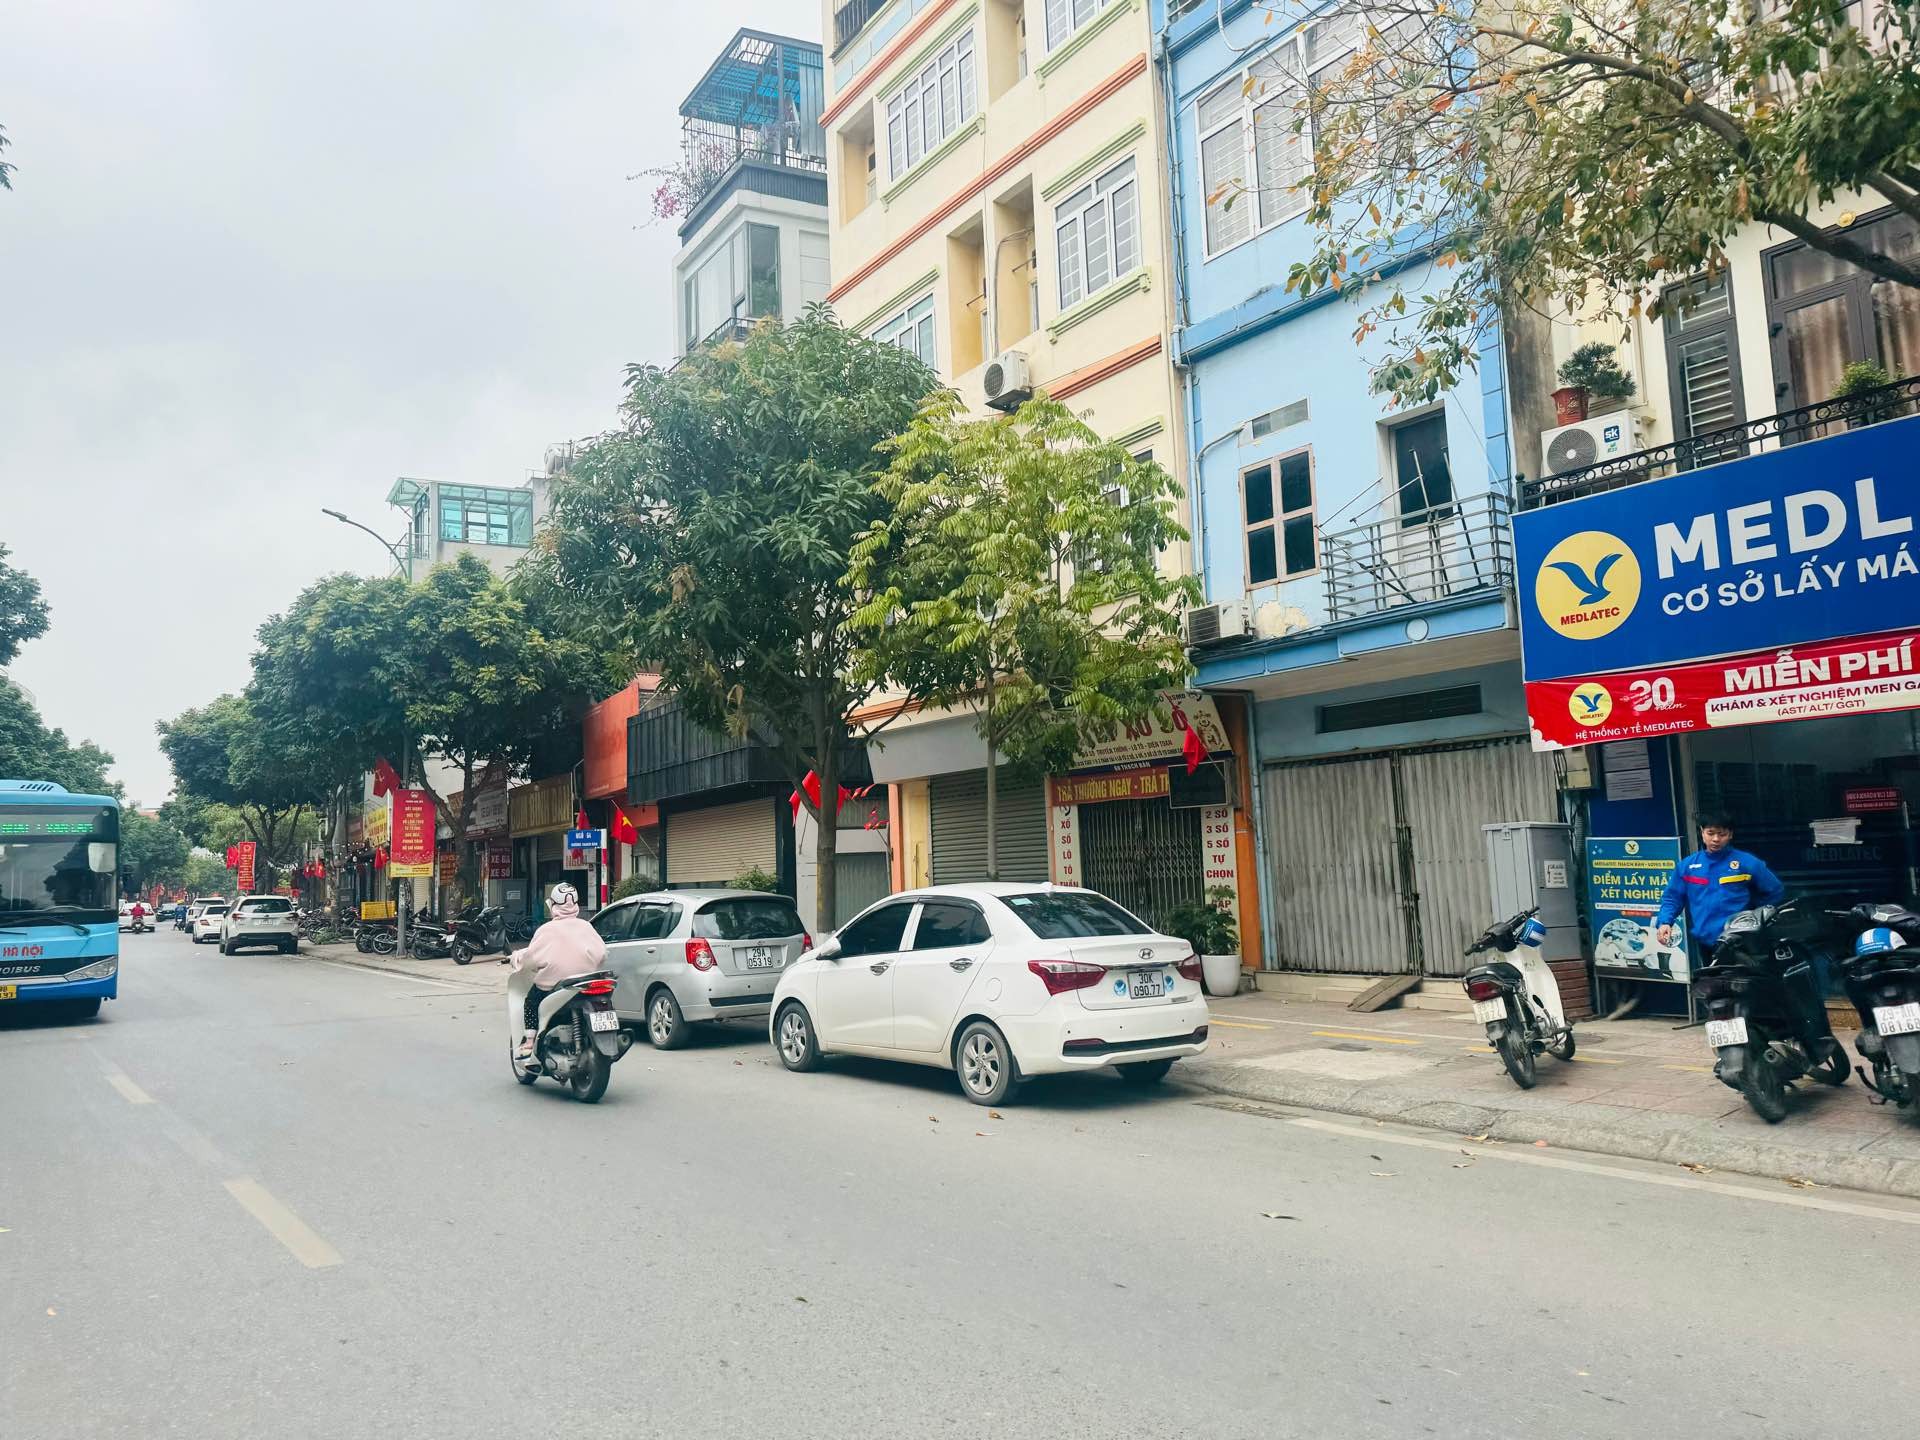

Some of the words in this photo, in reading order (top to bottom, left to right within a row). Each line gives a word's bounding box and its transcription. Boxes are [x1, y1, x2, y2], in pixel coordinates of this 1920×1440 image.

[1653, 477, 1913, 580] MEDL
[1661, 583, 1710, 616] CƠ
[1718, 570, 1765, 605] SỞ
[1775, 555, 1846, 598] LẤY
[1857, 542, 1919, 583] MÁ
[1560, 606, 1620, 626] MEDLATEC
[1724, 649, 1831, 693] MIỄN
[1838, 637, 1915, 679] PHÍ
[1711, 697, 1753, 713] KHÁM
[1756, 698, 1767, 708] &
[1768, 693, 1795, 705] XÉT
[1800, 687, 1861, 702] NGHIỆM
[1864, 682, 1901, 694] MEN
[1777, 706, 1807, 717] (AST/
[1809, 702, 1834, 713] ALT/
[1835, 699, 1866, 710] GGT)
[1575, 729, 1587, 741] HỆ
[1589, 723, 1621, 738] THỐNG
[1622, 727, 1630, 735] Y
[1630, 721, 1642, 734] TẾ
[1643, 719, 1695, 733] MEDLATEC
[1109, 777, 1131, 797] NGAY
[1140, 769, 1158, 794] TRẢ
[1205, 810, 1212, 819] 2
[1214, 807, 1228, 819] SỐ
[1206, 825, 1212, 834] 3
[1215, 822, 1229, 834] SỐ
[1207, 840, 1213, 849] 5
[1216, 837, 1230, 849] SỐ
[1212, 854, 1225, 865] TỰ
[1206, 869, 1234, 880] CHỌN
[1593, 870, 1621, 885] ĐIỂM
[1624, 871, 1646, 886] LẤY
[1649, 872, 1672, 886] MẪ
[1601, 886, 1620, 899] XÉT
[752, 948, 766, 958] 29A
[1139, 972, 1154, 984] 30K
[1133, 984, 1160, 996] 090.77
